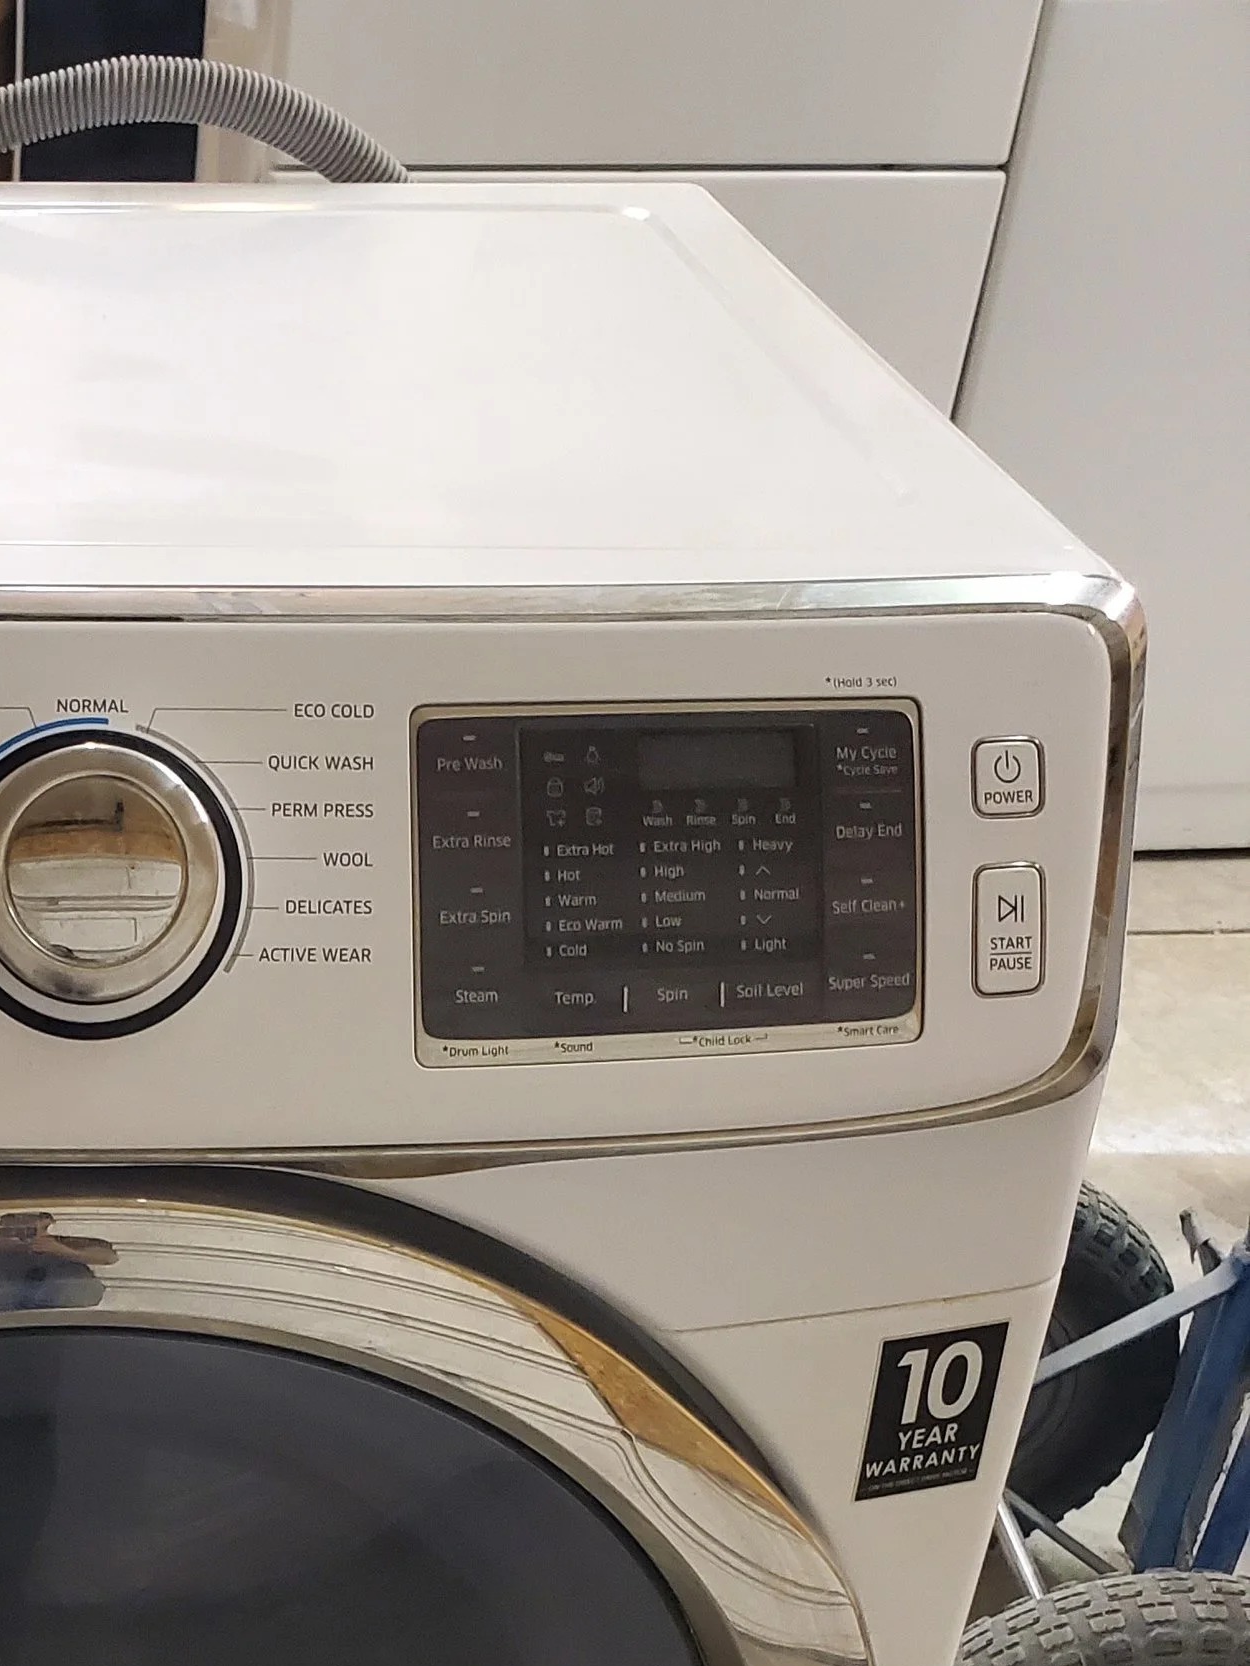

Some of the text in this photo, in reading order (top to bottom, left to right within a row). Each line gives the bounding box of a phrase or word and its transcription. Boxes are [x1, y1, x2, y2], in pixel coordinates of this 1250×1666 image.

[866, 677, 873, 687] 3
[876, 676, 897, 687] sec)
[56, 699, 129, 713] NORMAL
[294, 704, 375, 718] ECO COLD
[837, 747, 898, 761] My Cycle
[268, 756, 374, 771] QUICK WASH
[437, 757, 503, 772] Pre Wash
[984, 790, 1033, 805] POWER
[271, 803, 374, 818] PERM PRESS
[643, 815, 673, 826] Wash
[686, 815, 717, 826] Rinse
[732, 814, 756, 826] Spin
[775, 813, 797, 825] End
[836, 823, 903, 840] Delay End
[432, 834, 512, 849] Extra Rinse
[654, 839, 721, 853] Extra High
[753, 839, 793, 852] Heavy
[557, 843, 615, 856] Extra Hot
[323, 852, 373, 867] WOOL
[557, 869, 581, 881] Hot
[655, 866, 685, 879] High
[558, 894, 597, 907] Warm
[655, 890, 706, 902] Medium
[754, 887, 799, 900] Normal
[285, 900, 372, 914] DELICATES
[832, 899, 859, 915] Self
[440, 910, 511, 924] Extra Spin
[655, 915, 682, 927] Low
[559, 918, 623, 932] Eco Warm
[656, 940, 705, 953] No Spin
[755, 938, 787, 952] Light
[990, 936, 1032, 950] START
[259, 948, 371, 962] ACTIVE WEAR
[559, 944, 588, 957] Cold
[990, 957, 1032, 971] PAUSE
[828, 973, 910, 991] Super Speed
[455, 989, 498, 1003] Steam
[657, 988, 688, 1003] Spin
[736, 983, 803, 998] Soil Level
[877, 1025, 899, 1036] Care
[728, 1035, 751, 1047] Lock
[482, 1045, 509, 1057] Light
[898, 1340, 983, 1425] 10
[898, 1422, 959, 1451] YEAR
[865, 1443, 981, 1479] WARRANTY
